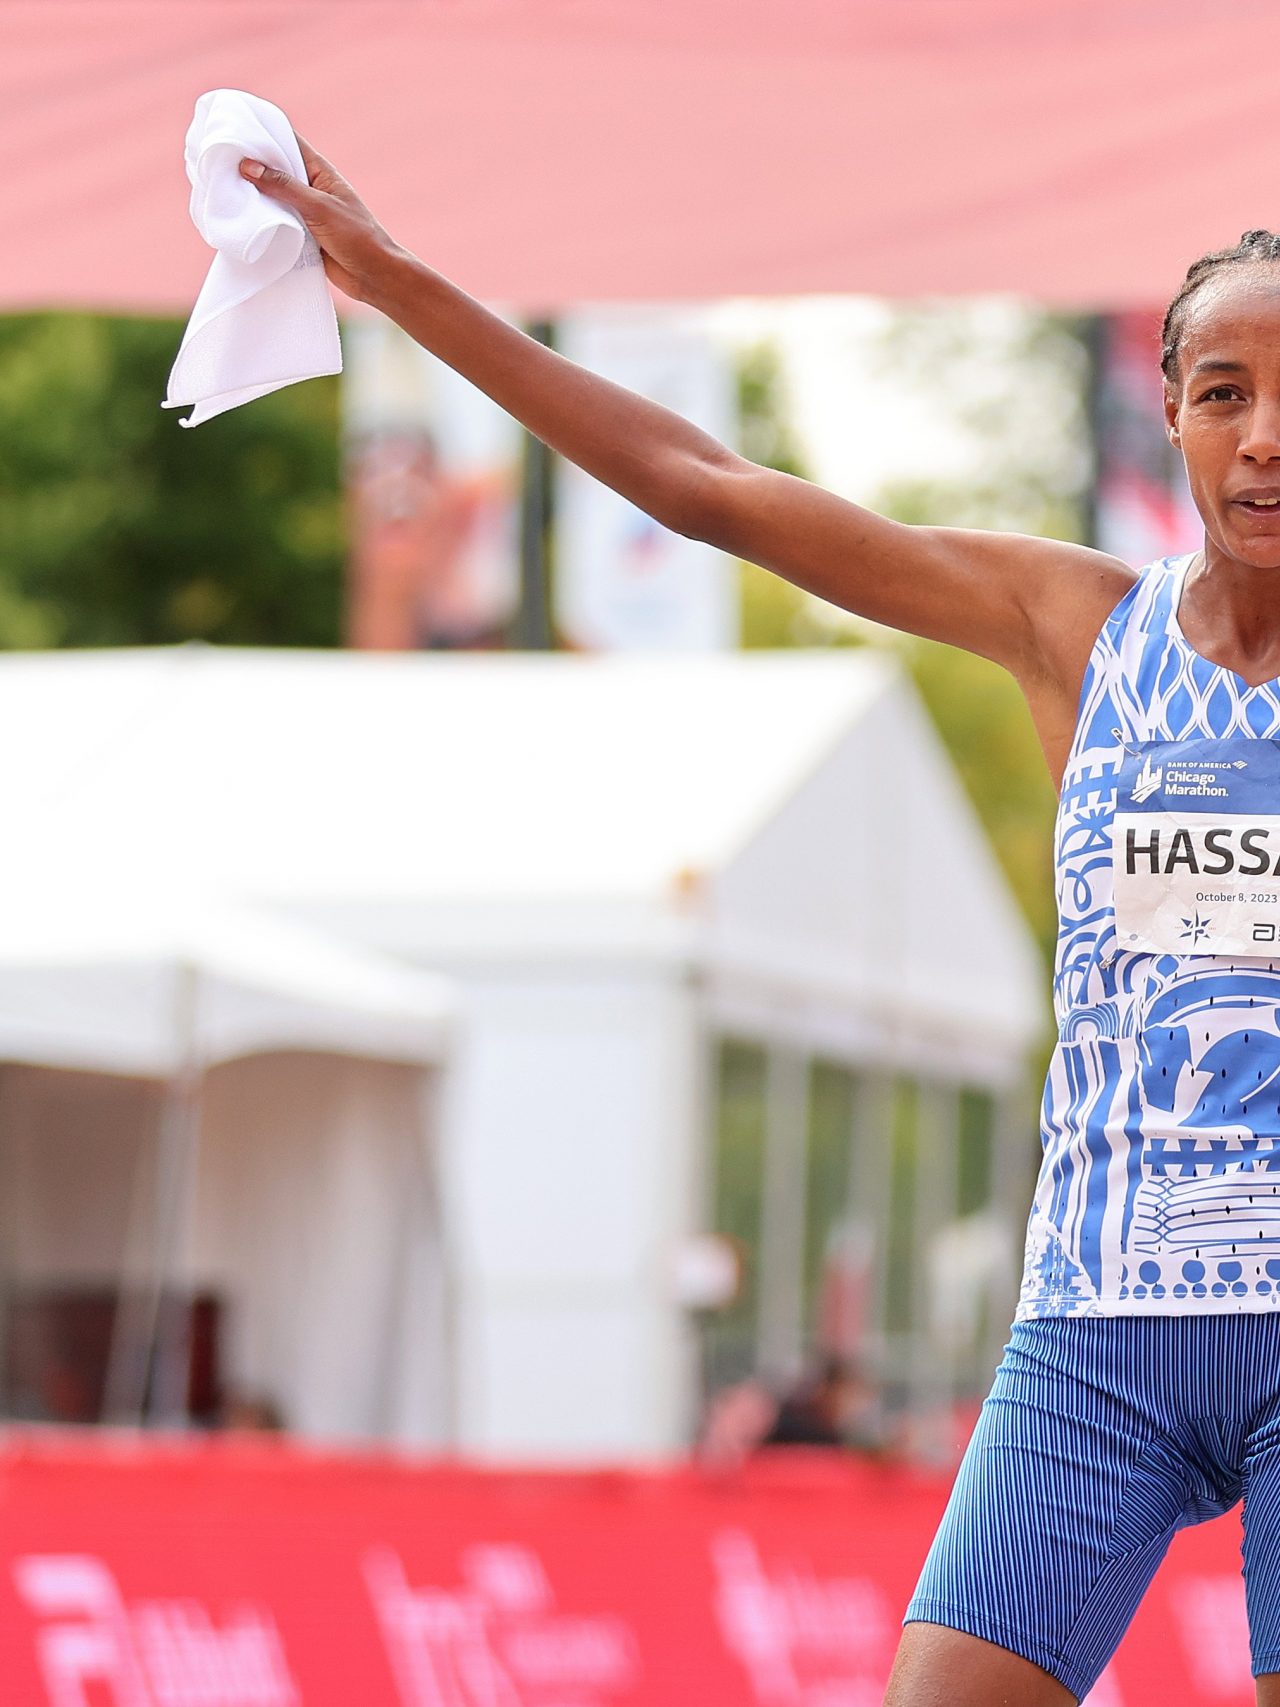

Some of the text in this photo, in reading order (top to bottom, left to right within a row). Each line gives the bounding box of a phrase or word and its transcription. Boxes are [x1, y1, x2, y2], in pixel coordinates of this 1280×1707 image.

[1166, 770, 1216, 786] Chicago
[1195, 891, 1278, 903] October 8, 2023
